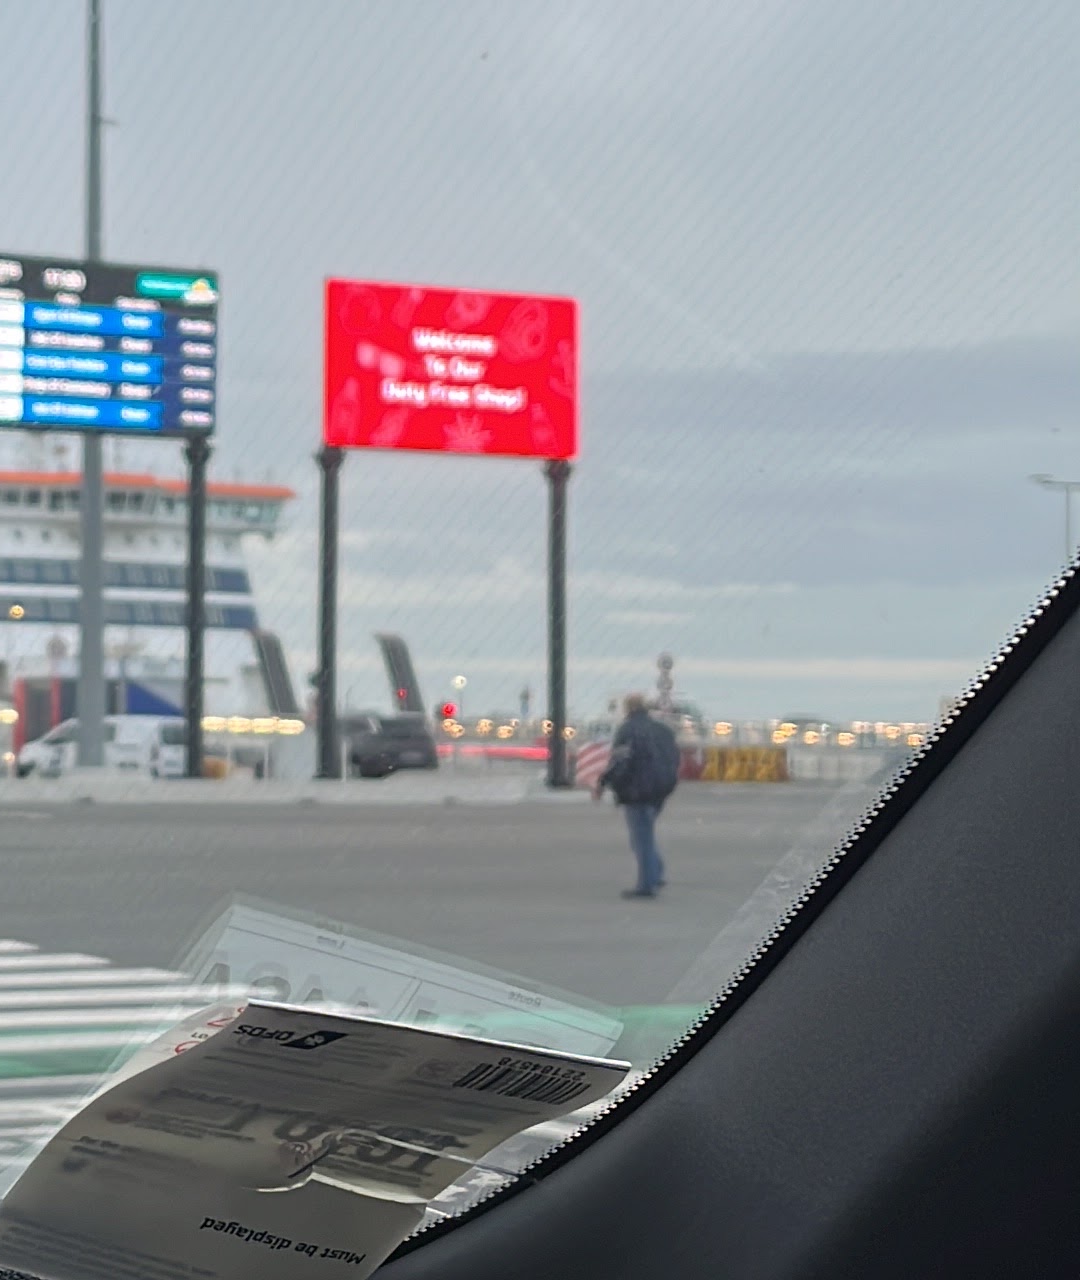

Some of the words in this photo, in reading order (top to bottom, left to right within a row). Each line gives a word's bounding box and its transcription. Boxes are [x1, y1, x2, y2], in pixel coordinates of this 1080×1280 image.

[233, 1024, 295, 1041] DFDS
[200, 1217, 292, 1250] displayed
[295, 1242, 318, 1258] be
[320, 1247, 366, 1265] Must
